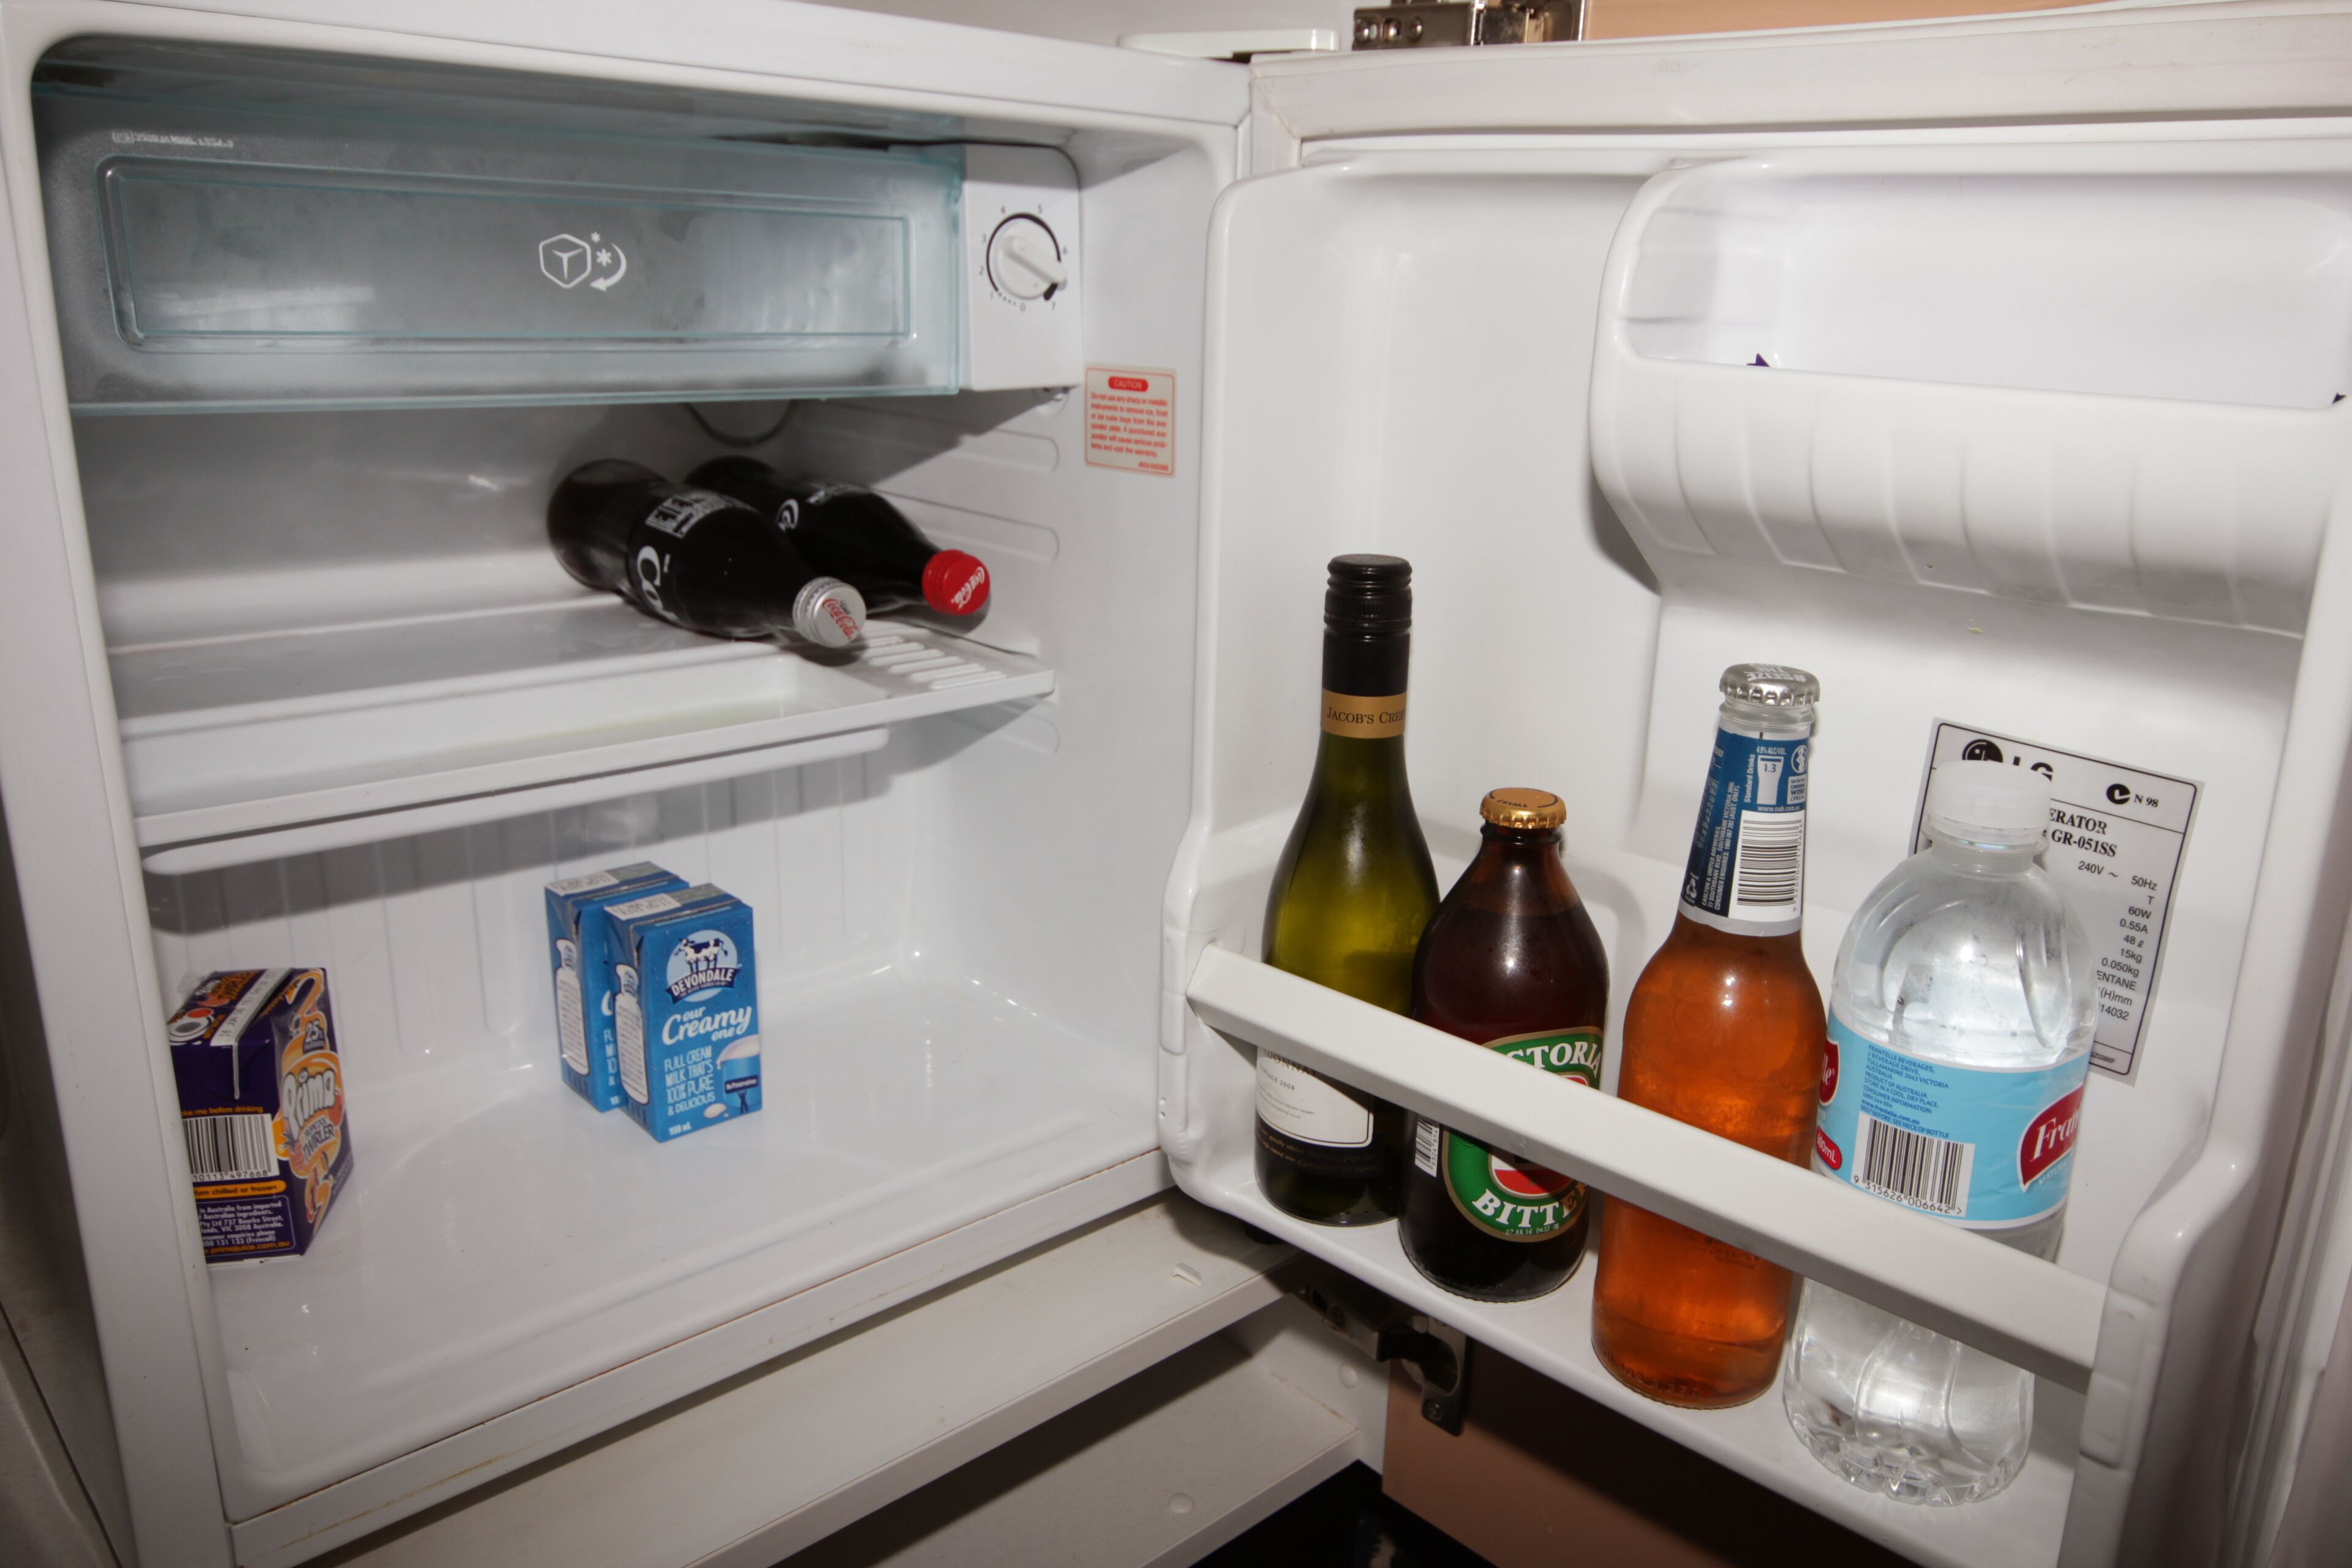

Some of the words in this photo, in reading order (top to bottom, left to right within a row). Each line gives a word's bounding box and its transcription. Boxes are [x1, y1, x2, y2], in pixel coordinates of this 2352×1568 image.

[1114, 379, 1142, 389] CAUTION
[1327, 707, 1374, 724] JACOB'S
[1747, 754, 1755, 773] Drinks
[1763, 763, 1776, 772] 1.3
[1744, 774, 1754, 803] Standard
[1496, 799, 1528, 808] TWIST
[1722, 794, 1732, 818] VICTORIA
[2134, 794, 2143, 804] N
[2146, 797, 2159, 808] 98
[2050, 808, 2108, 835] ERATOR
[1718, 819, 1727, 851] SOUTHBANK
[2052, 829, 2117, 858] GR-051SS
[1709, 869, 1719, 901] SOUTHBANK
[2078, 861, 2105, 875] 240V
[2132, 875, 2157, 891] 50Hz
[1702, 881, 1711, 906] CARLTON
[1714, 880, 1724, 910] CONSUMER
[2147, 895, 2154, 905] T
[2128, 907, 2152, 919] 60W
[2119, 919, 2148, 933] 0.55A
[2124, 935, 2136, 945] 48
[2120, 948, 2143, 964] 15kg
[2101, 957, 2139, 978] 0.050kg
[671, 968, 734, 997] DEVONDALE
[2097, 970, 2137, 990] ENTANE
[682, 1006, 706, 1022] our
[2098, 1002, 2130, 1020] 14032
[662, 1006, 752, 1046] Creamy
[711, 1027, 735, 1041] one
[664, 1055, 686, 1072] FULL
[686, 1045, 712, 1064] CREAM
[1868, 1044, 1898, 1061] FRANTELLE
[1898, 1057, 1935, 1073] BEVERAGES,
[1871, 1053, 1899, 1068] BEVERAGE
[665, 1069, 687, 1087] MILK
[1865, 1071, 1888, 1085] PRODUCT
[1867, 1057, 1904, 1077] TULLAMARINE
[1904, 1072, 1918, 1082] 3043
[1920, 1077, 1949, 1089] VICTORIA
[666, 1084, 687, 1104] 100%
[687, 1074, 715, 1096] PURE
[1280, 1079, 1295, 1091] 2008
[1863, 1085, 1890, 1100] CONSUMER
[1864, 1078, 1879, 1089] STORE
[1890, 1090, 1906, 1099] COOL,
[282, 1068, 336, 1140] Prima
[668, 1106, 674, 1117] &
[675, 1091, 716, 1113] DELICIOUS
[1861, 1104, 1872, 1114] BEST
[1926, 1128, 1950, 1138] BOTTLE
[1853, 1175, 1860, 1184] 9
[1865, 1180, 1903, 1203] 315626
[1907, 1197, 1951, 1214] 006642
[253, 1200, 282, 1210] imported
